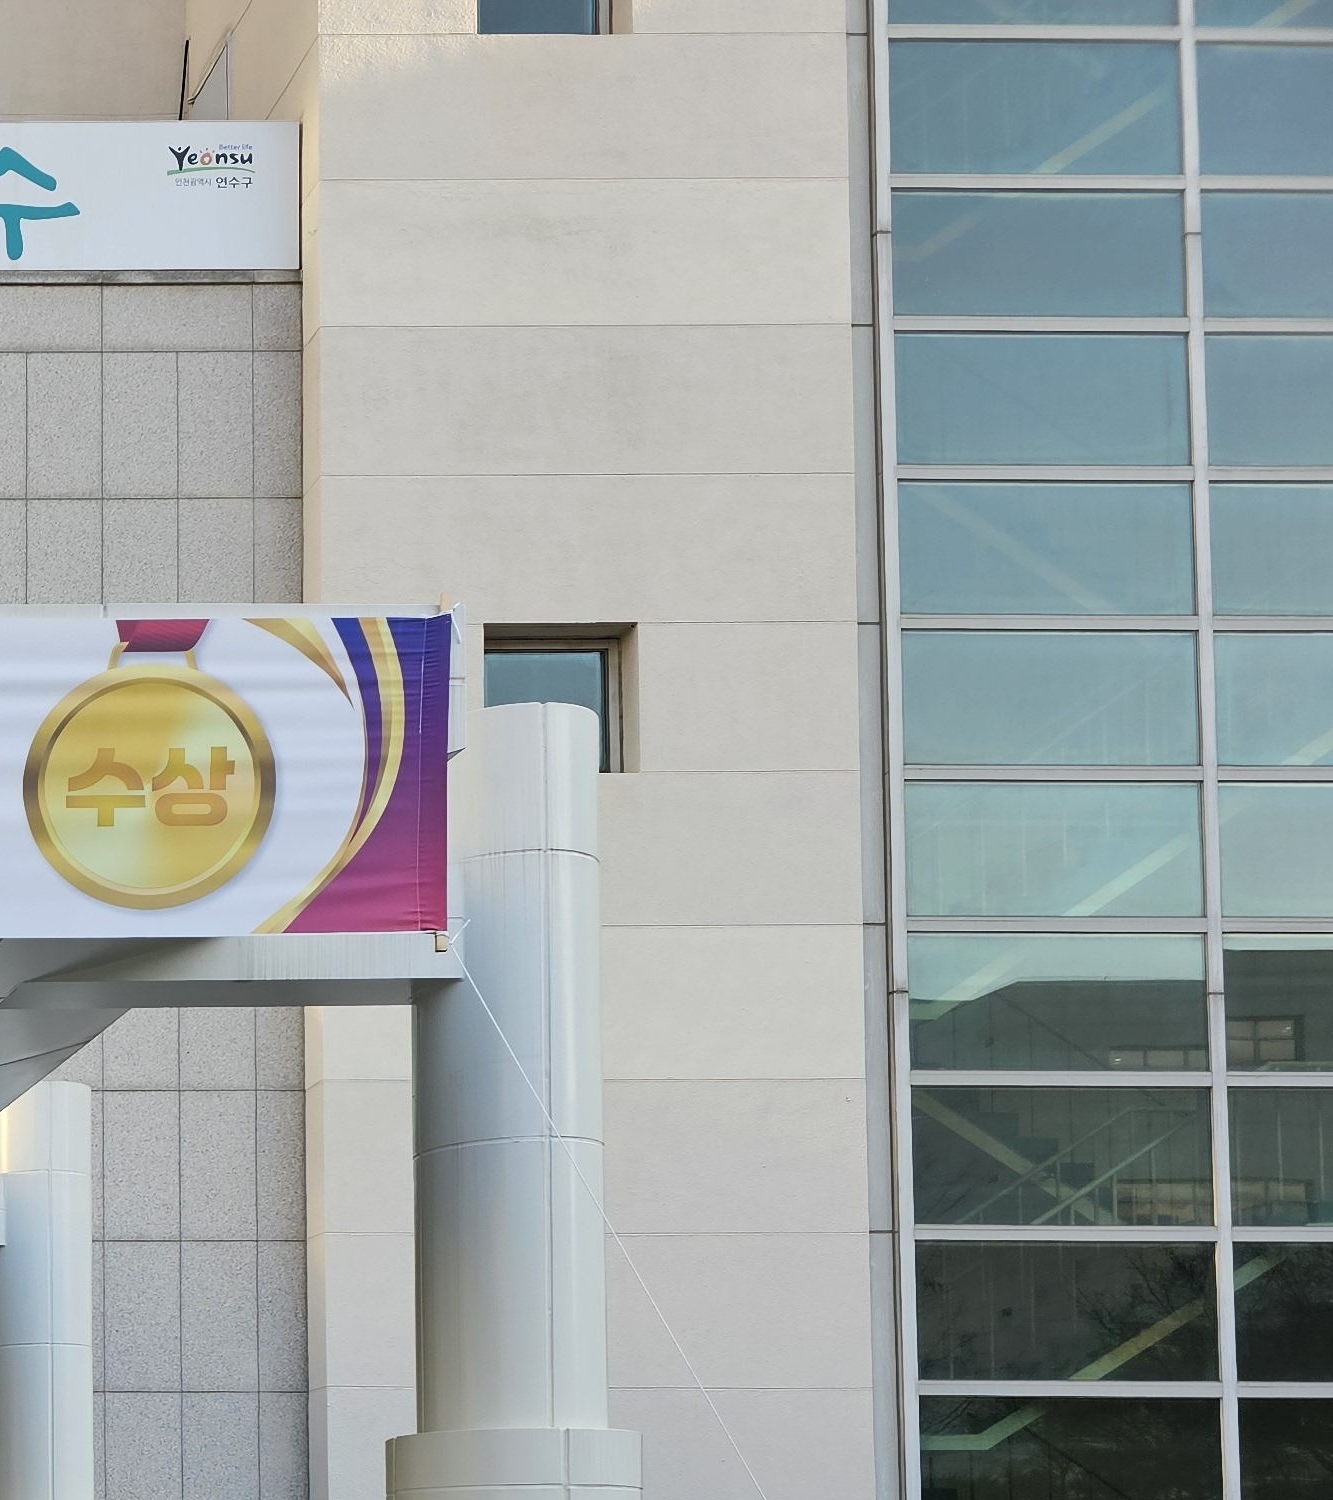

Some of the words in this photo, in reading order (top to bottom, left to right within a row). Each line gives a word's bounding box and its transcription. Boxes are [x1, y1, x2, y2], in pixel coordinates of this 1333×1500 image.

[168, 145, 253, 171] Yeonsu
[175, 178, 212, 187] 인천광역시
[216, 176, 253, 188] 연수구
[65, 746, 236, 828] 수상
